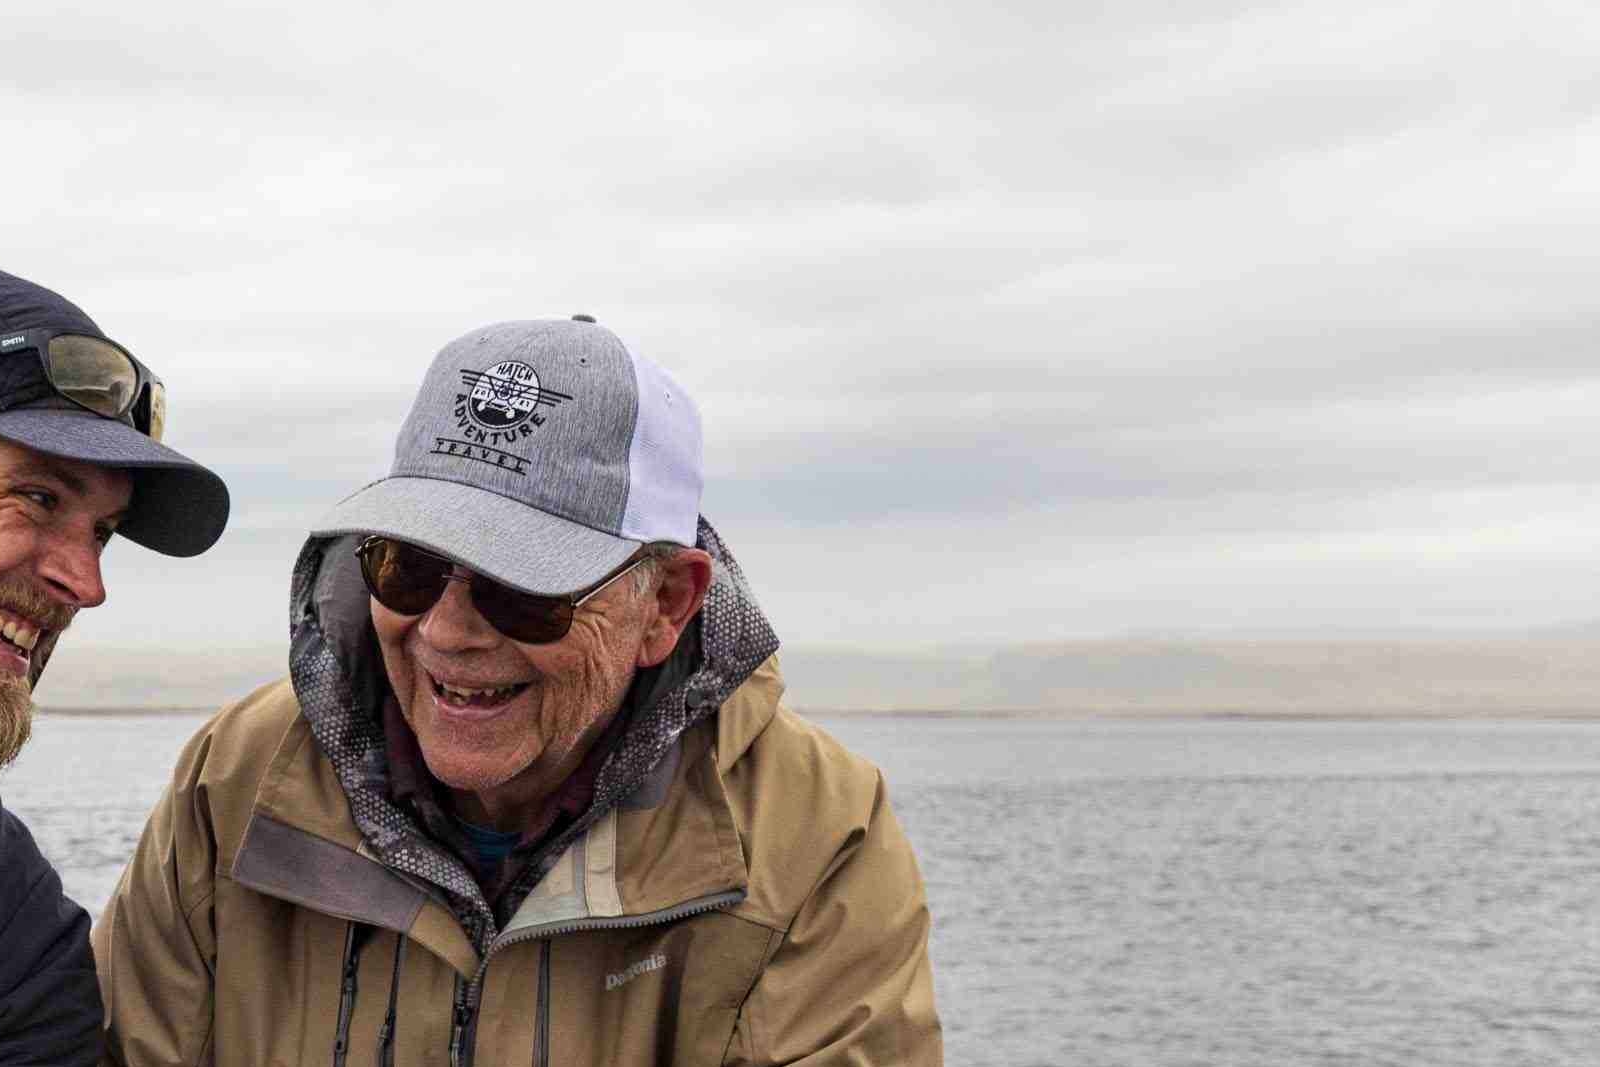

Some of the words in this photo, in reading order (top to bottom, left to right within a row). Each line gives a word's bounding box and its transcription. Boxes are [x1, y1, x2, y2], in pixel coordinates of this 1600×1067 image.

[496, 363, 533, 381] HATCH
[455, 394, 546, 446] ADVENTURE
[435, 441, 524, 472] TRAVEL
[605, 952, 667, 991] paonia
